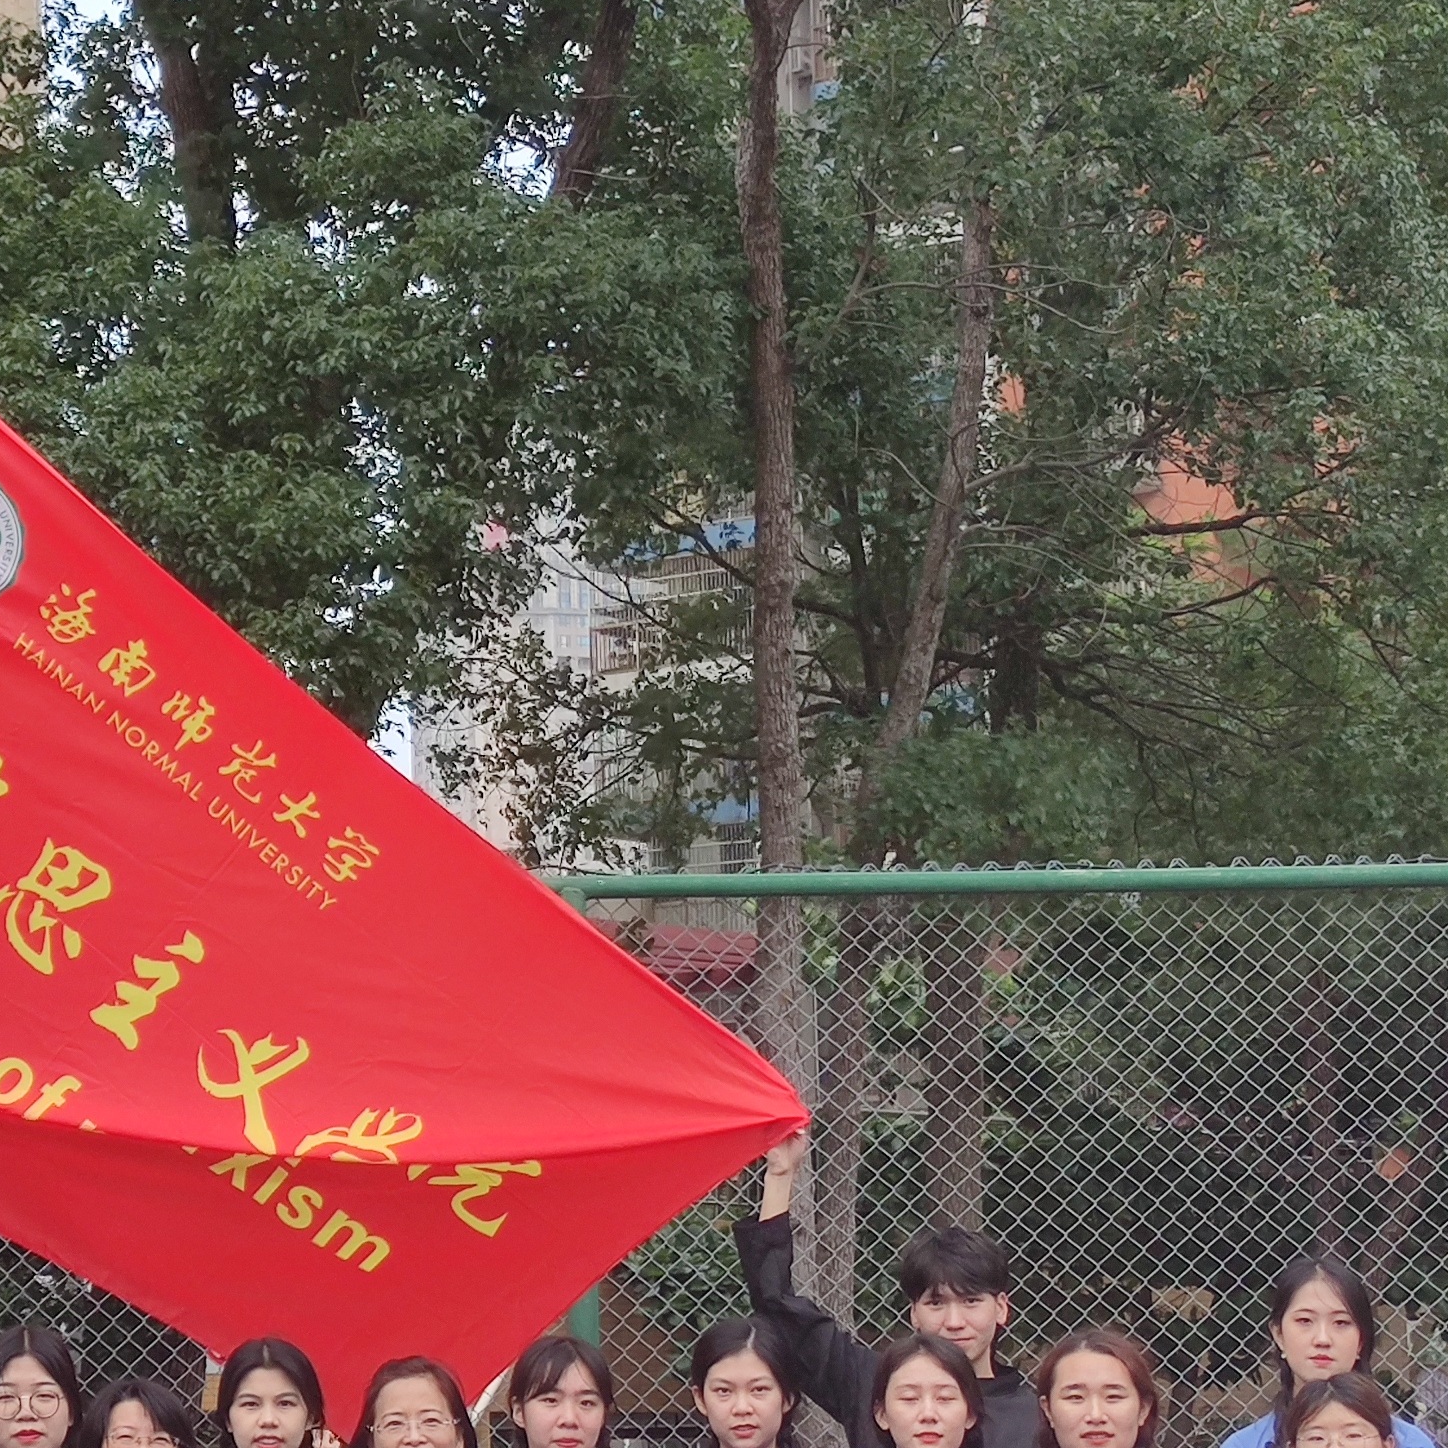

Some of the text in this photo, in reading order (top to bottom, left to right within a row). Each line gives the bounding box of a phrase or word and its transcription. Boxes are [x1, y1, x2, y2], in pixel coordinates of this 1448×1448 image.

[12, 632, 338, 911] HAINAN NORMAL UNIVERSITY
[38, 583, 380, 883] 海南师范大学
